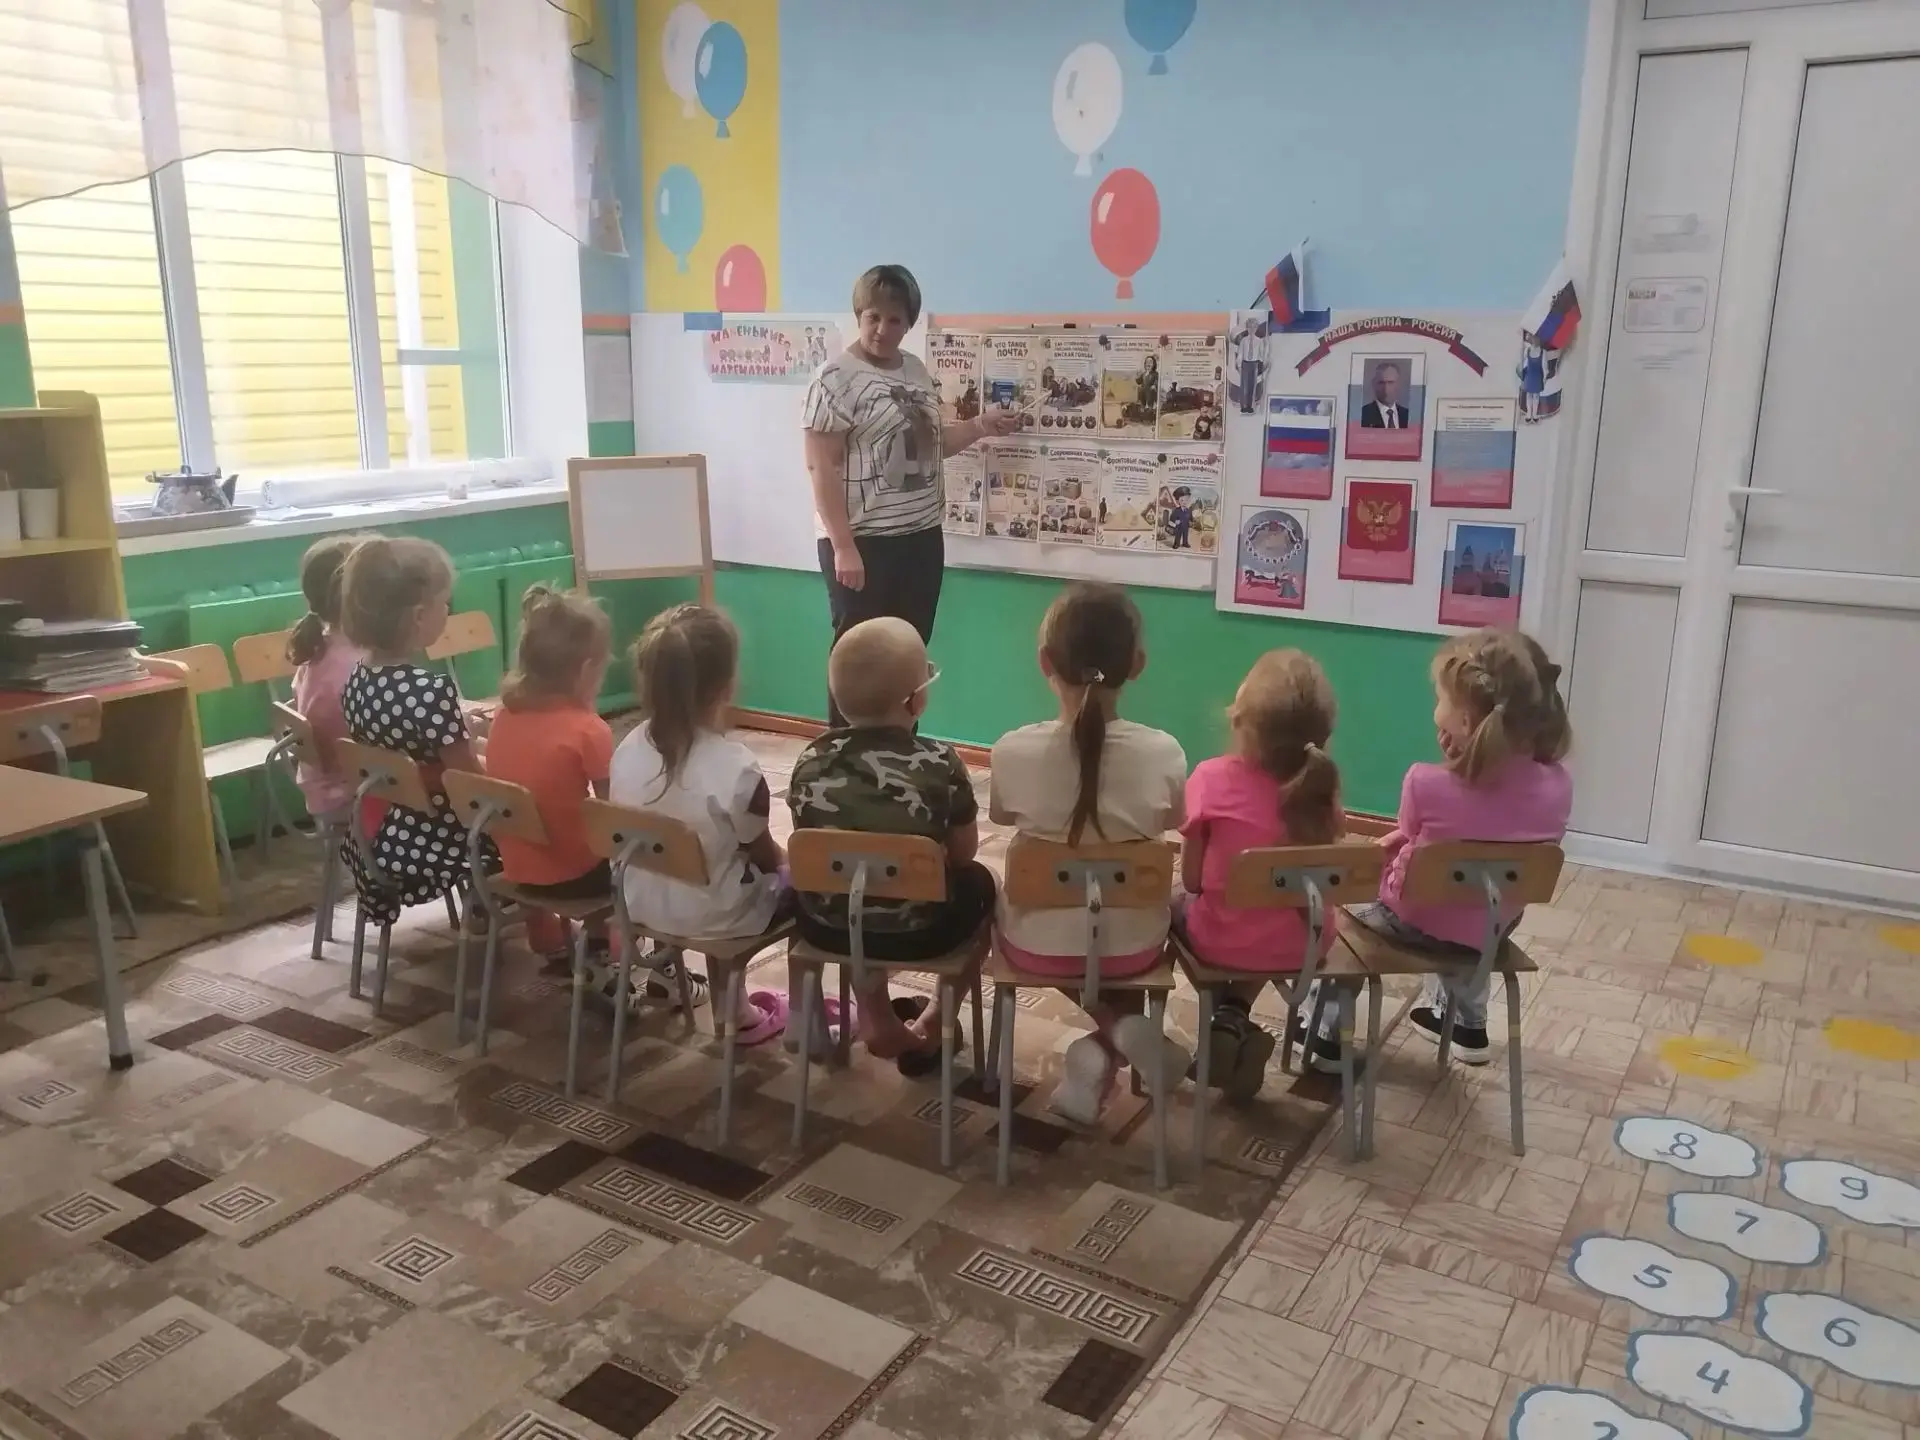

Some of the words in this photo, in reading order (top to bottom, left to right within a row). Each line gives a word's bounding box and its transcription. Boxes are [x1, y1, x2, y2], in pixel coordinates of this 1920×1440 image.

[1324, 322, 1355, 342] НАША
[1357, 316, 1402, 332] РОДИНА
[1411, 318, 1457, 341] РОССИЯ
[994, 341, 1007, 349] ЧТО
[996, 348, 1029, 358] ПОЧТА?
[937, 359, 973, 370] ПОЧТЫ
[1173, 457, 1213, 466] Почтальо
[1668, 1131, 1698, 1160] 8
[1839, 1176, 1869, 1201] 9
[1734, 1210, 1760, 1235] 7
[1632, 1263, 1673, 1290] 5
[1823, 1317, 1861, 1348] 6
[1696, 1361, 1731, 1395] 4
